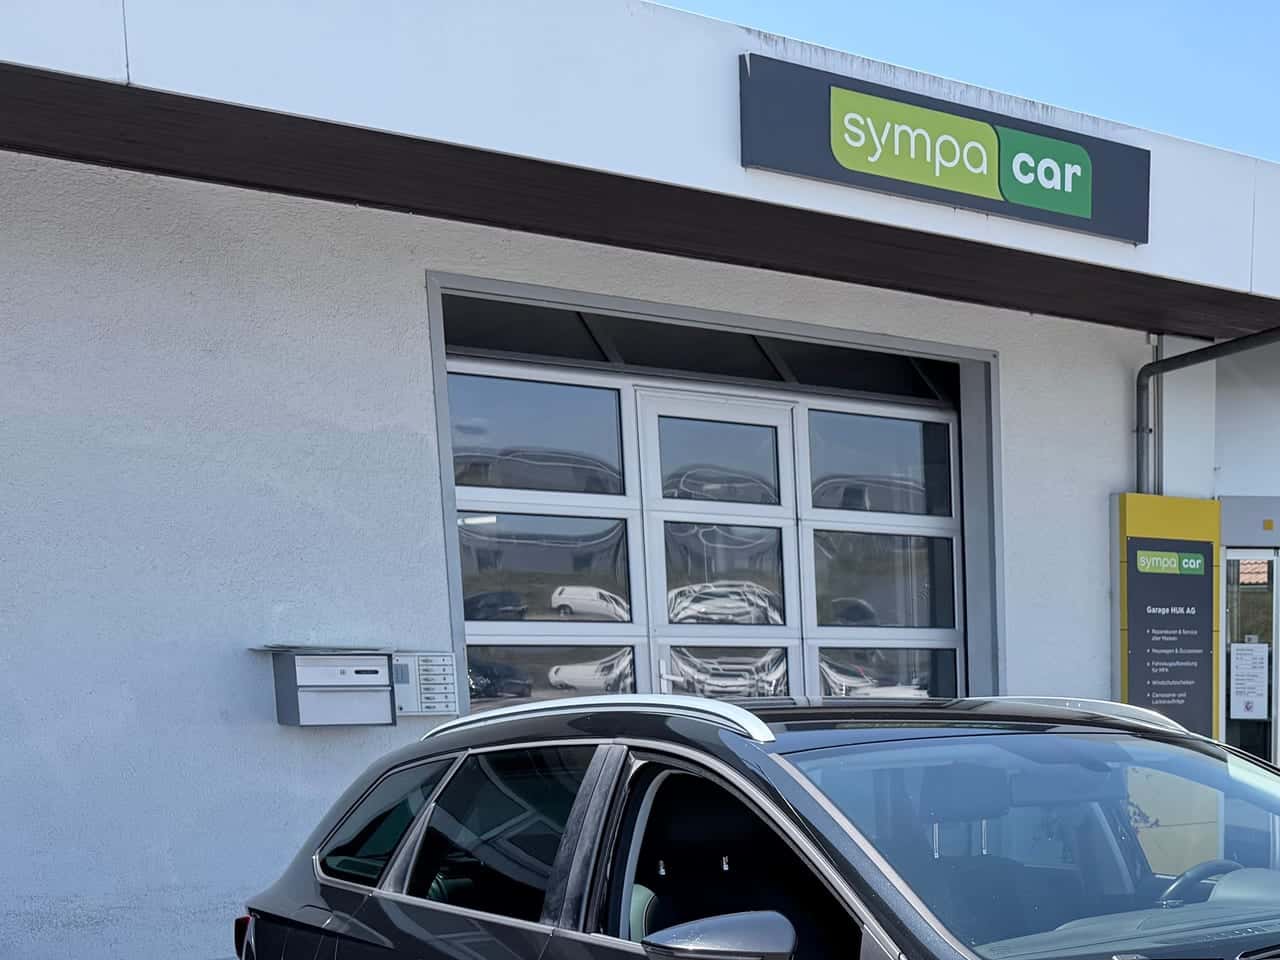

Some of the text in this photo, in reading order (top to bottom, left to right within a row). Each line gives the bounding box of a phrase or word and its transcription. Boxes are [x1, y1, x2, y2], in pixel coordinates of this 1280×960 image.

[843, 111, 1081, 193] sympa car
[1139, 556, 1202, 569] sympa car
